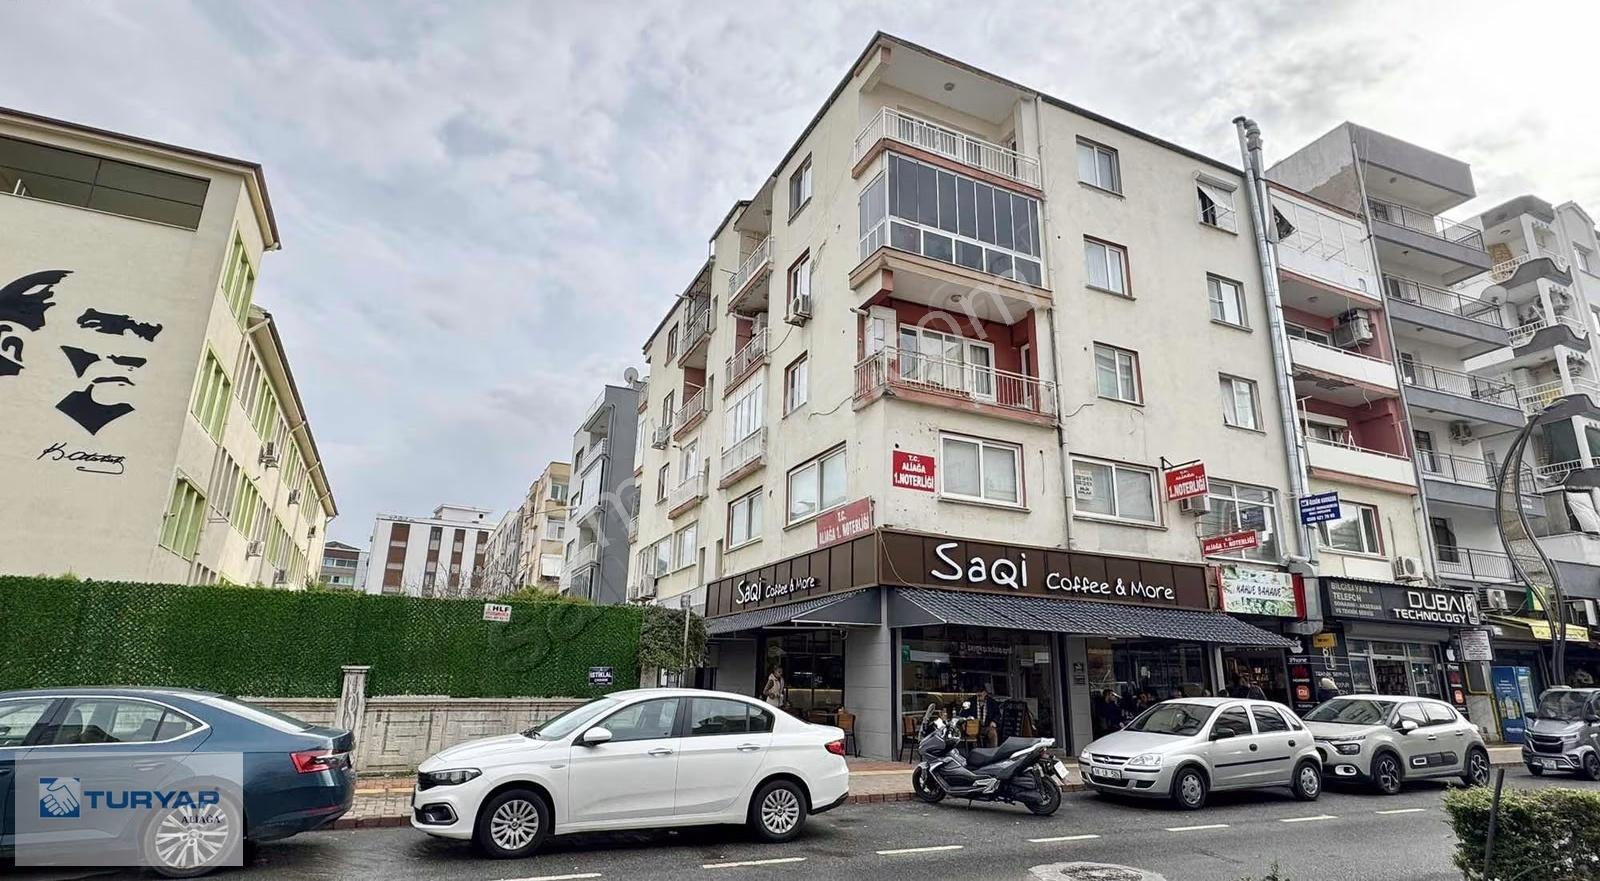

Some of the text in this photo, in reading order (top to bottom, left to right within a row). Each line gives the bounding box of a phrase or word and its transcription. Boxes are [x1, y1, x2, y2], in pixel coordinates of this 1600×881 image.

[765, 583, 788, 598] Coffee
[795, 576, 815, 589] More
[1046, 572, 1111, 595] Coffee
[1115, 577, 1127, 596] &
[1131, 581, 1175, 599] More
[1407, 591, 1466, 613] DUBAI
[1393, 608, 1467, 624] TECHNOLOGY
